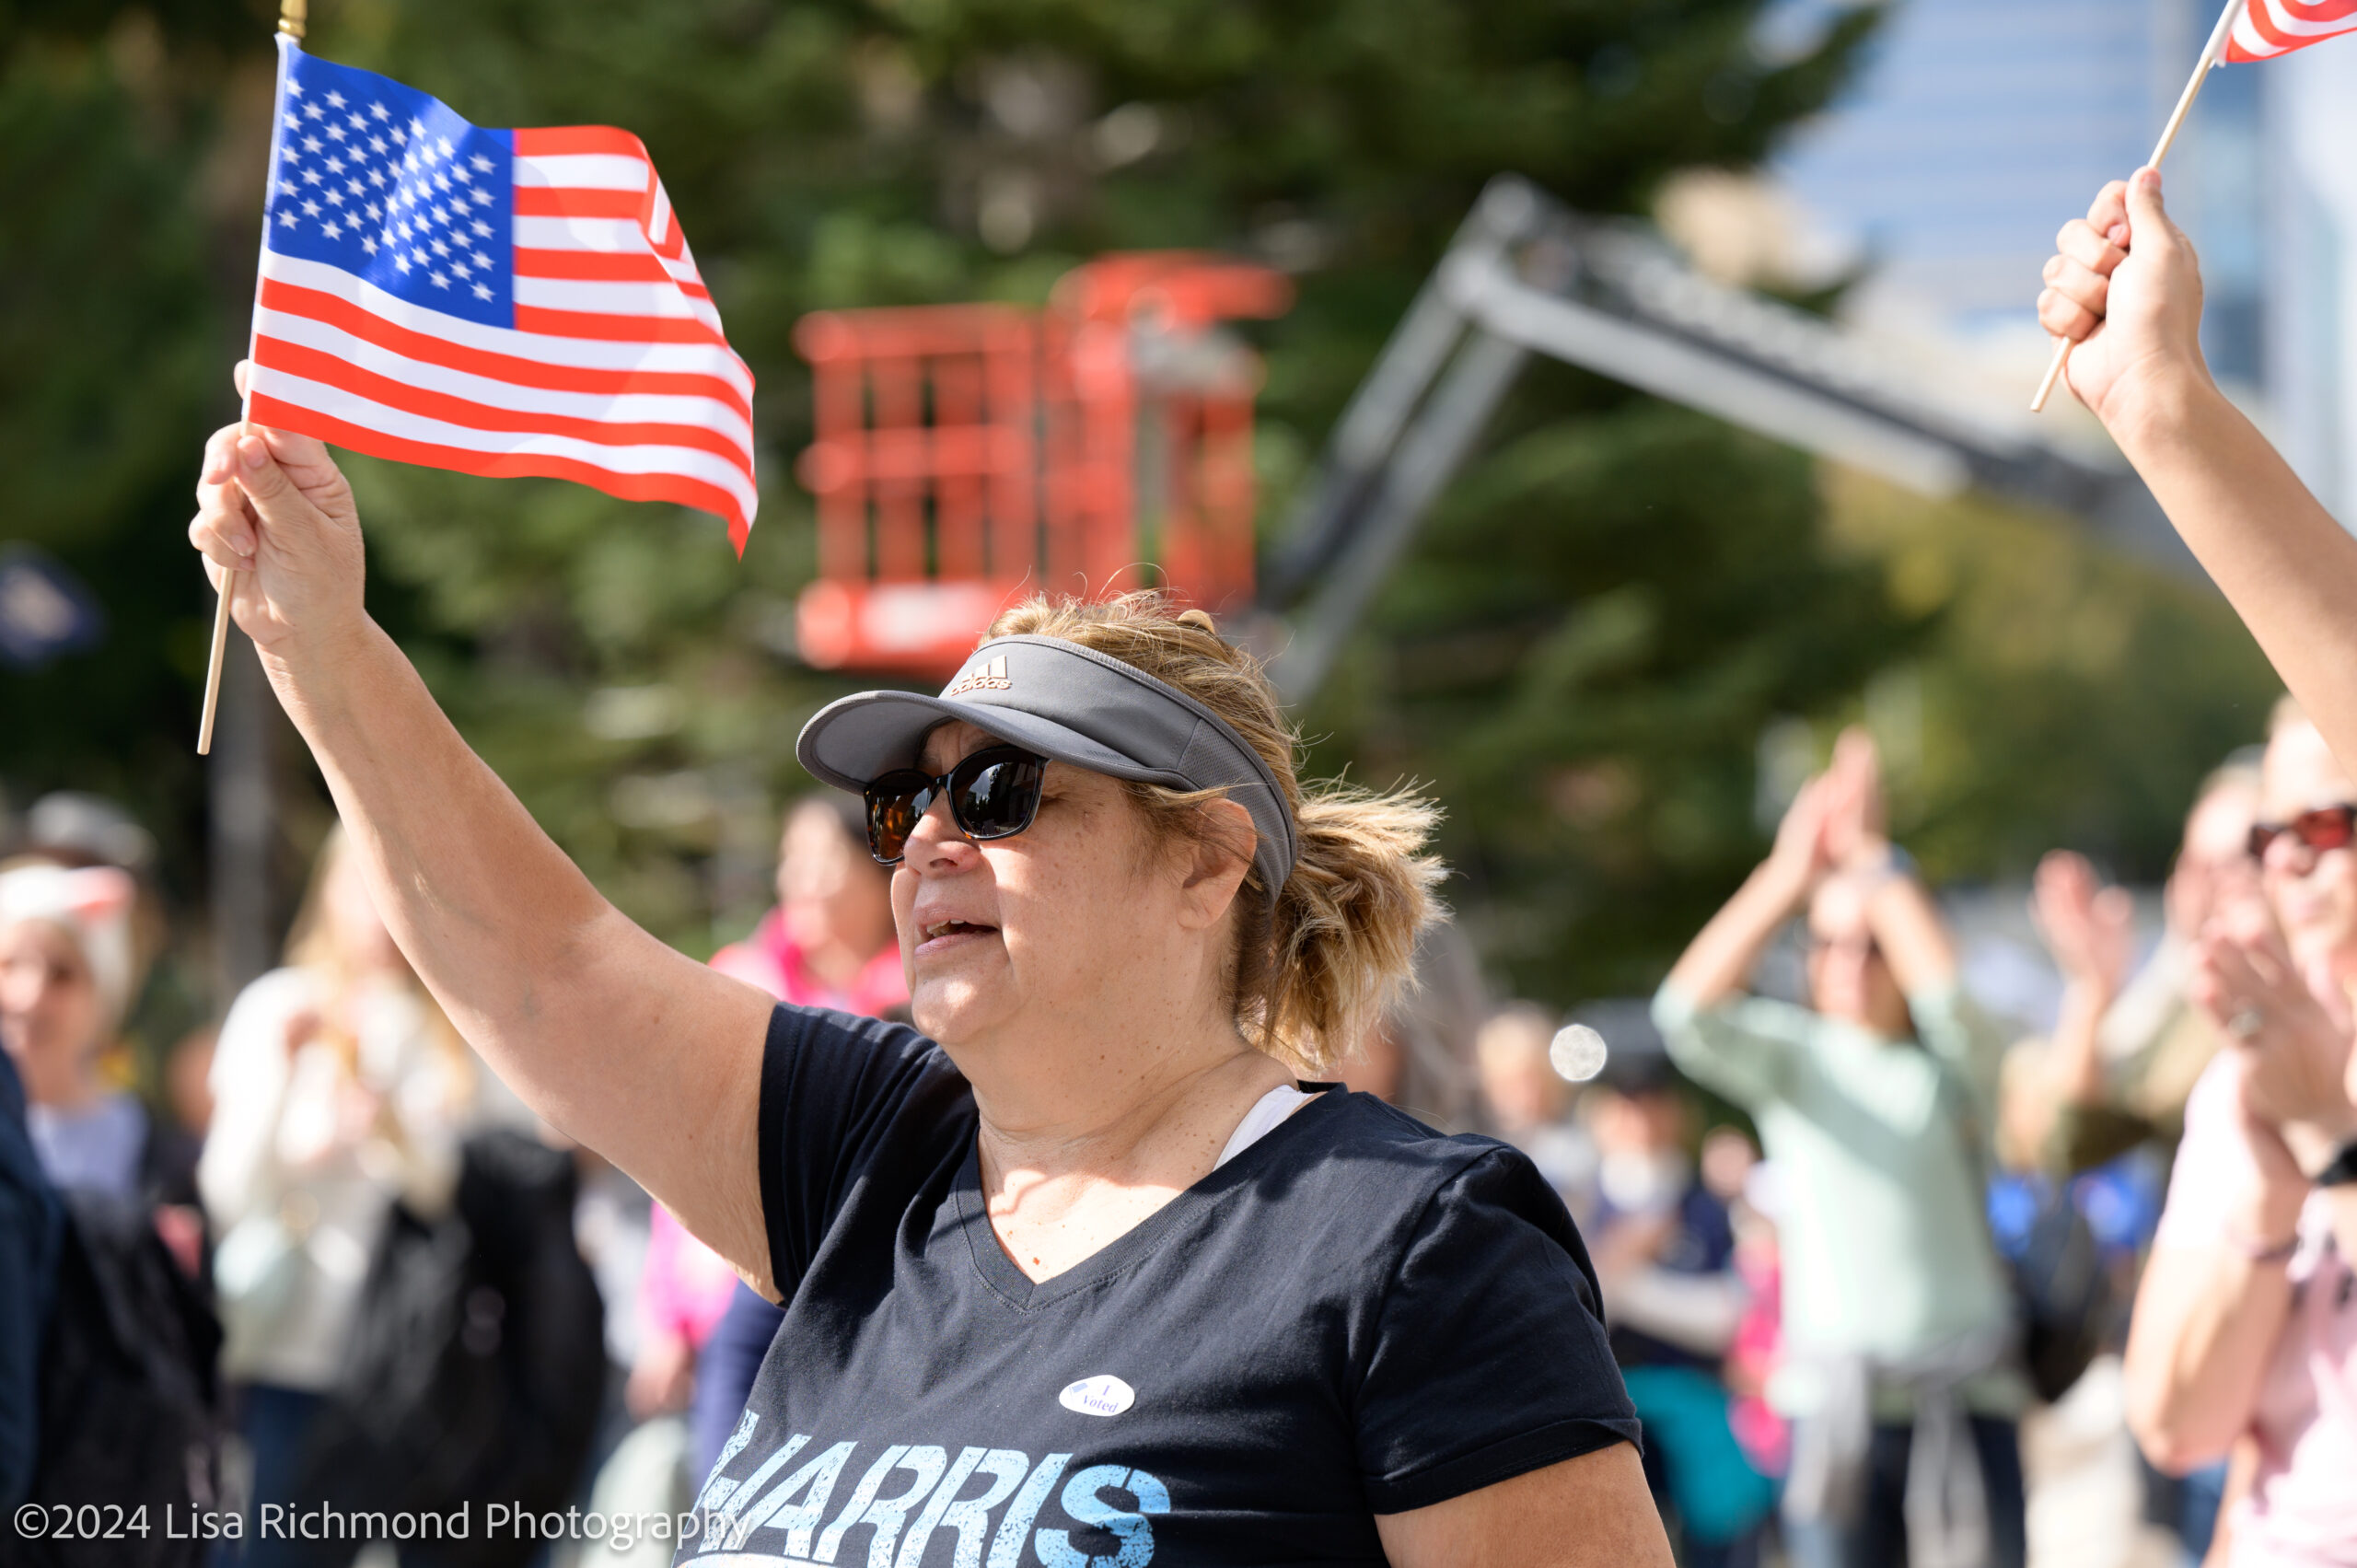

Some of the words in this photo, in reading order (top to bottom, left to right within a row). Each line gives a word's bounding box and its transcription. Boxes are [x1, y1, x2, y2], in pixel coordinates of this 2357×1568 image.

[950, 676, 1012, 697] adidas
[1102, 1385, 1110, 1397] I
[1082, 1394, 1120, 1413] Voted
[691, 1409, 1172, 1568] HARRIS
